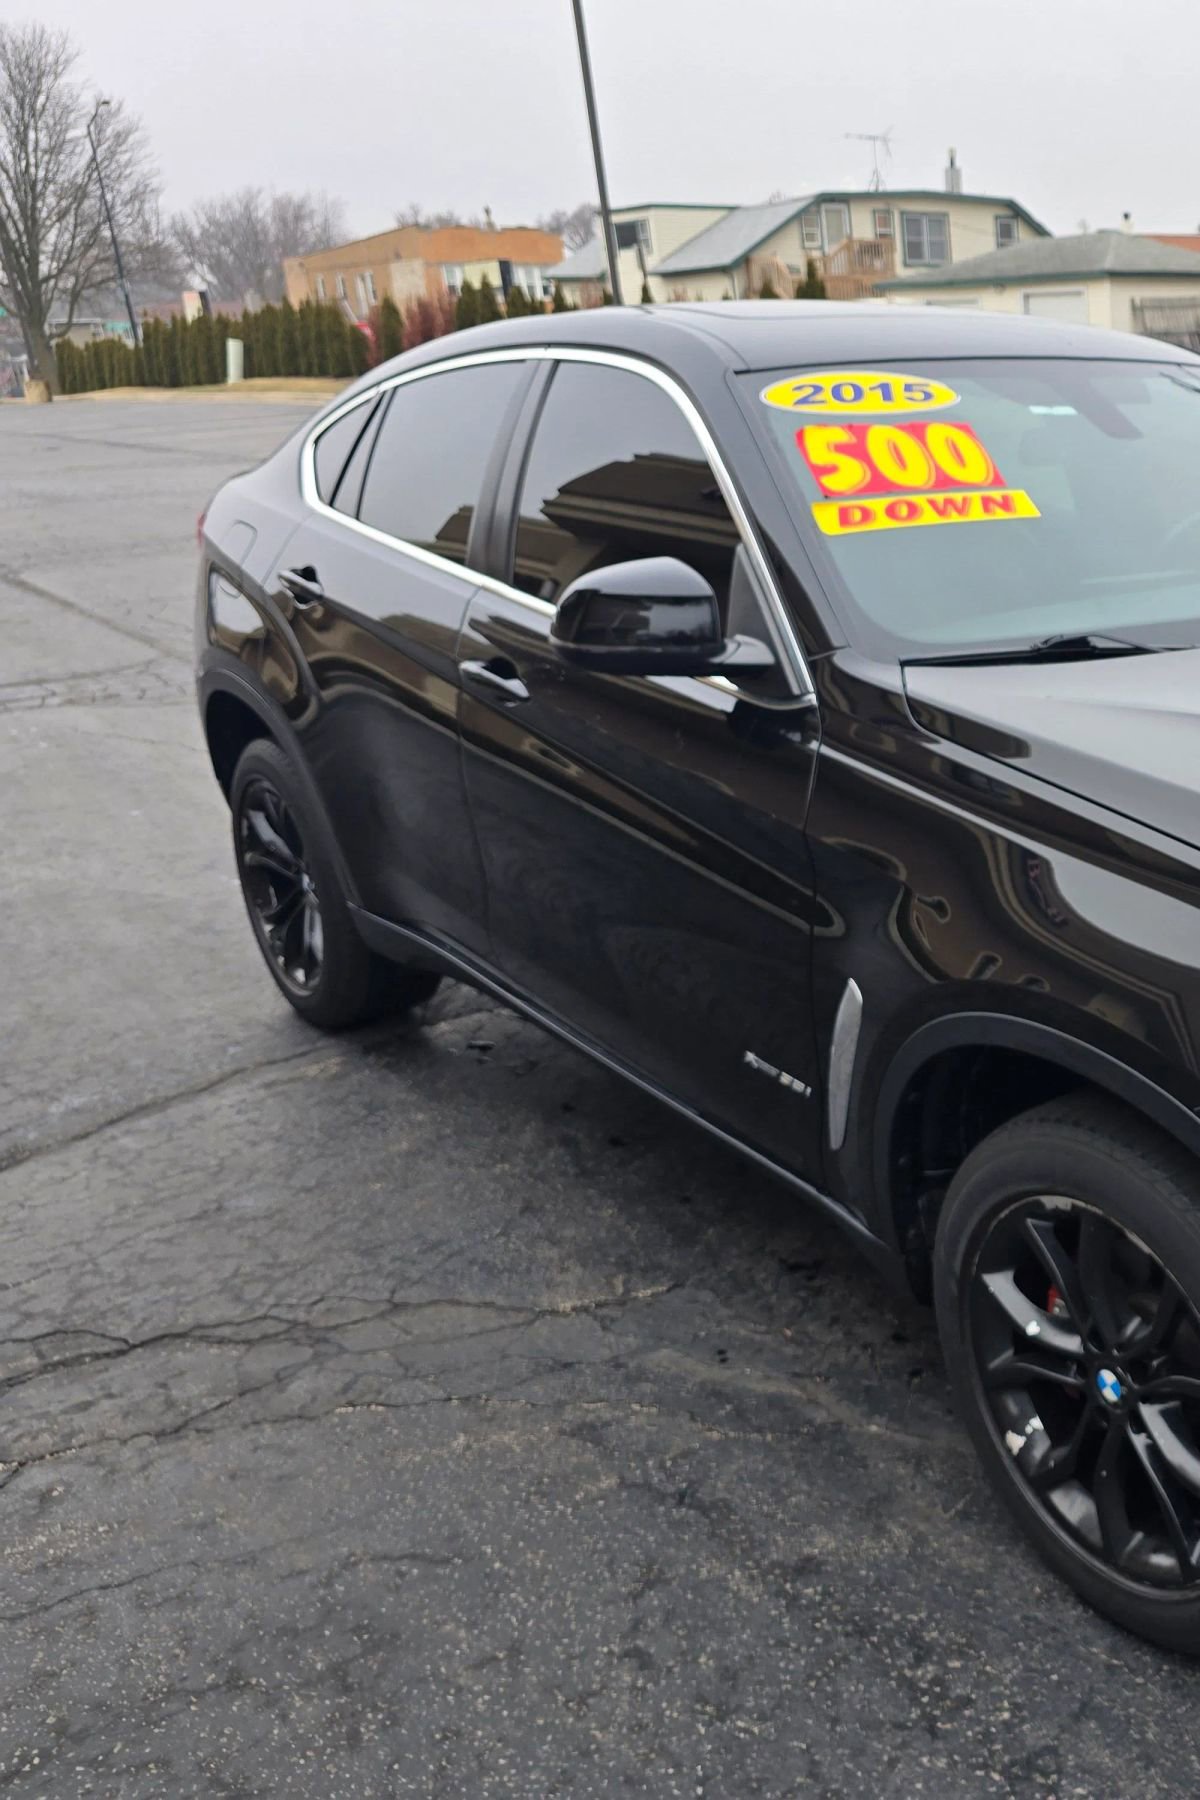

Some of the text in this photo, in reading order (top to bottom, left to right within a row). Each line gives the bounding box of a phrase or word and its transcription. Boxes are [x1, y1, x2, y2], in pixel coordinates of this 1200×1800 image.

[791, 382, 934, 405] 2015
[803, 422, 994, 493] 500
[838, 495, 1017, 528] DOWN
